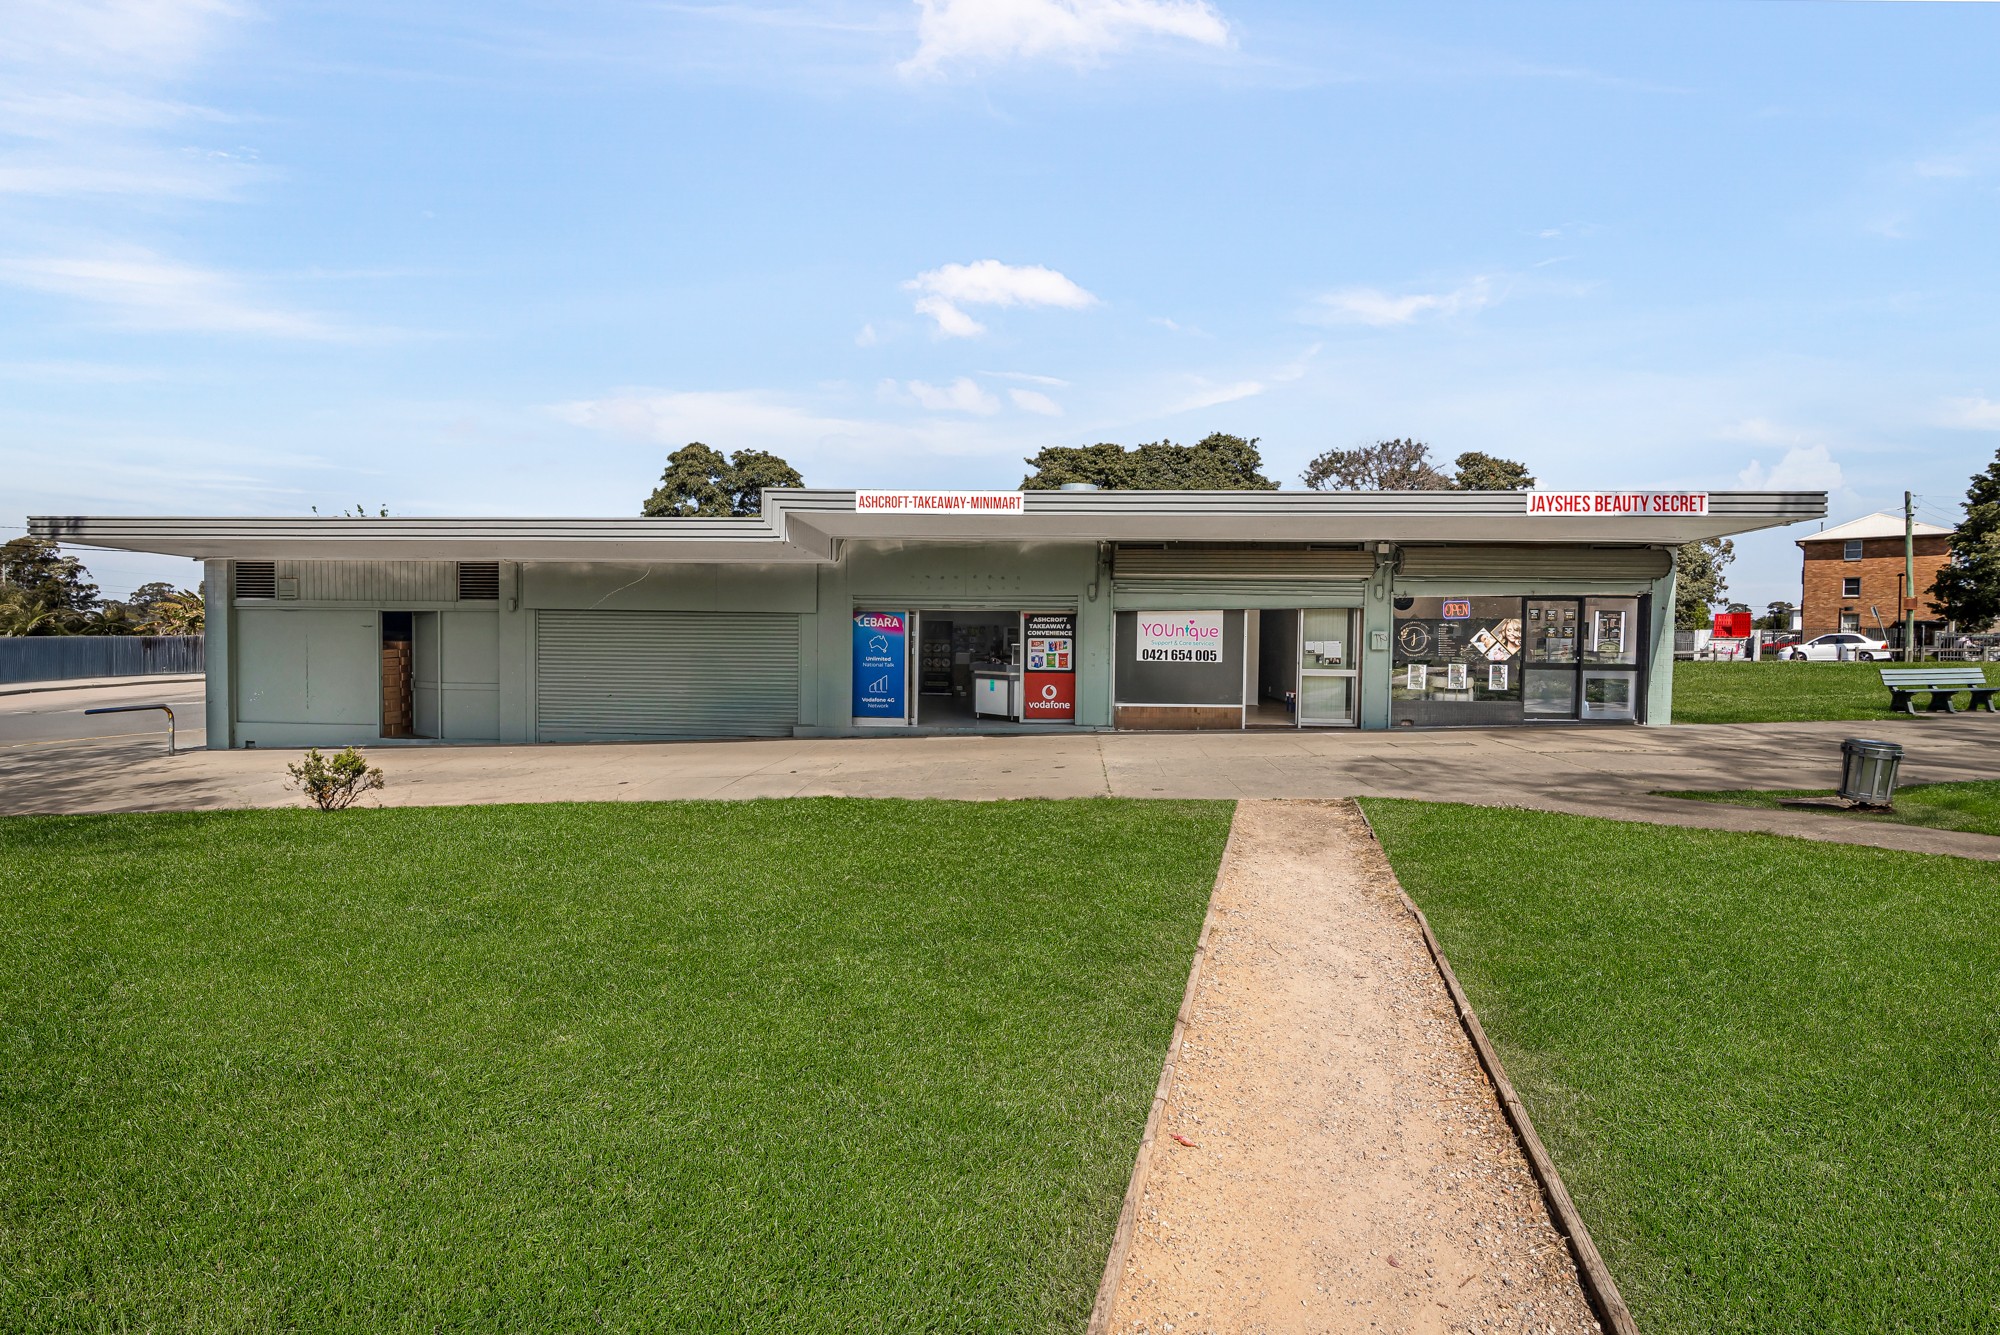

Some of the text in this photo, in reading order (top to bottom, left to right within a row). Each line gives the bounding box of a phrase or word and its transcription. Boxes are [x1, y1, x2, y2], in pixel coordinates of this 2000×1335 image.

[858, 495, 1022, 510] ASHCROFT-TAKEAWAY-MINIMART
[1530, 495, 1706, 512] JAYSHES BEAUTY SECRET
[1444, 603, 1469, 616] OPEN
[858, 617, 899, 627] LEBARA
[1142, 648, 1217, 661] 0421 654 005
[1028, 700, 1071, 710] vodafone
